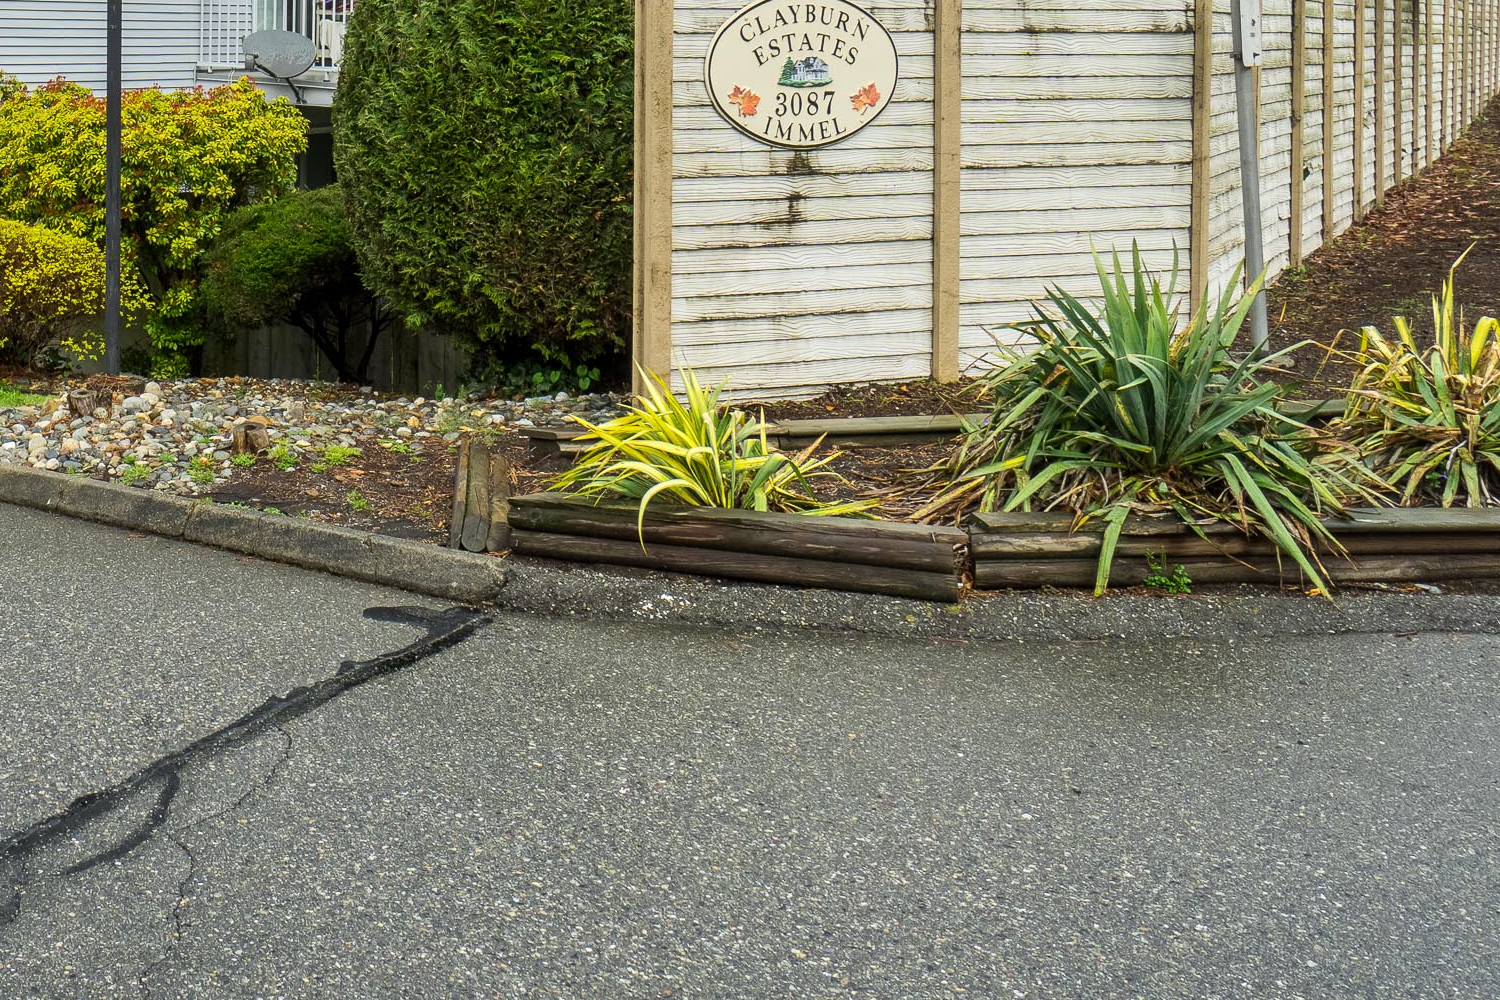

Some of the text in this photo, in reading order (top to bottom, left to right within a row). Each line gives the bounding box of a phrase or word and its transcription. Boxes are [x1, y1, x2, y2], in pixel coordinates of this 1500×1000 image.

[739, 4, 870, 43] CLAYBURN
[751, 32, 859, 67] ESTATES
[775, 90, 835, 117] 3087
[763, 116, 847, 142] IMMEL
